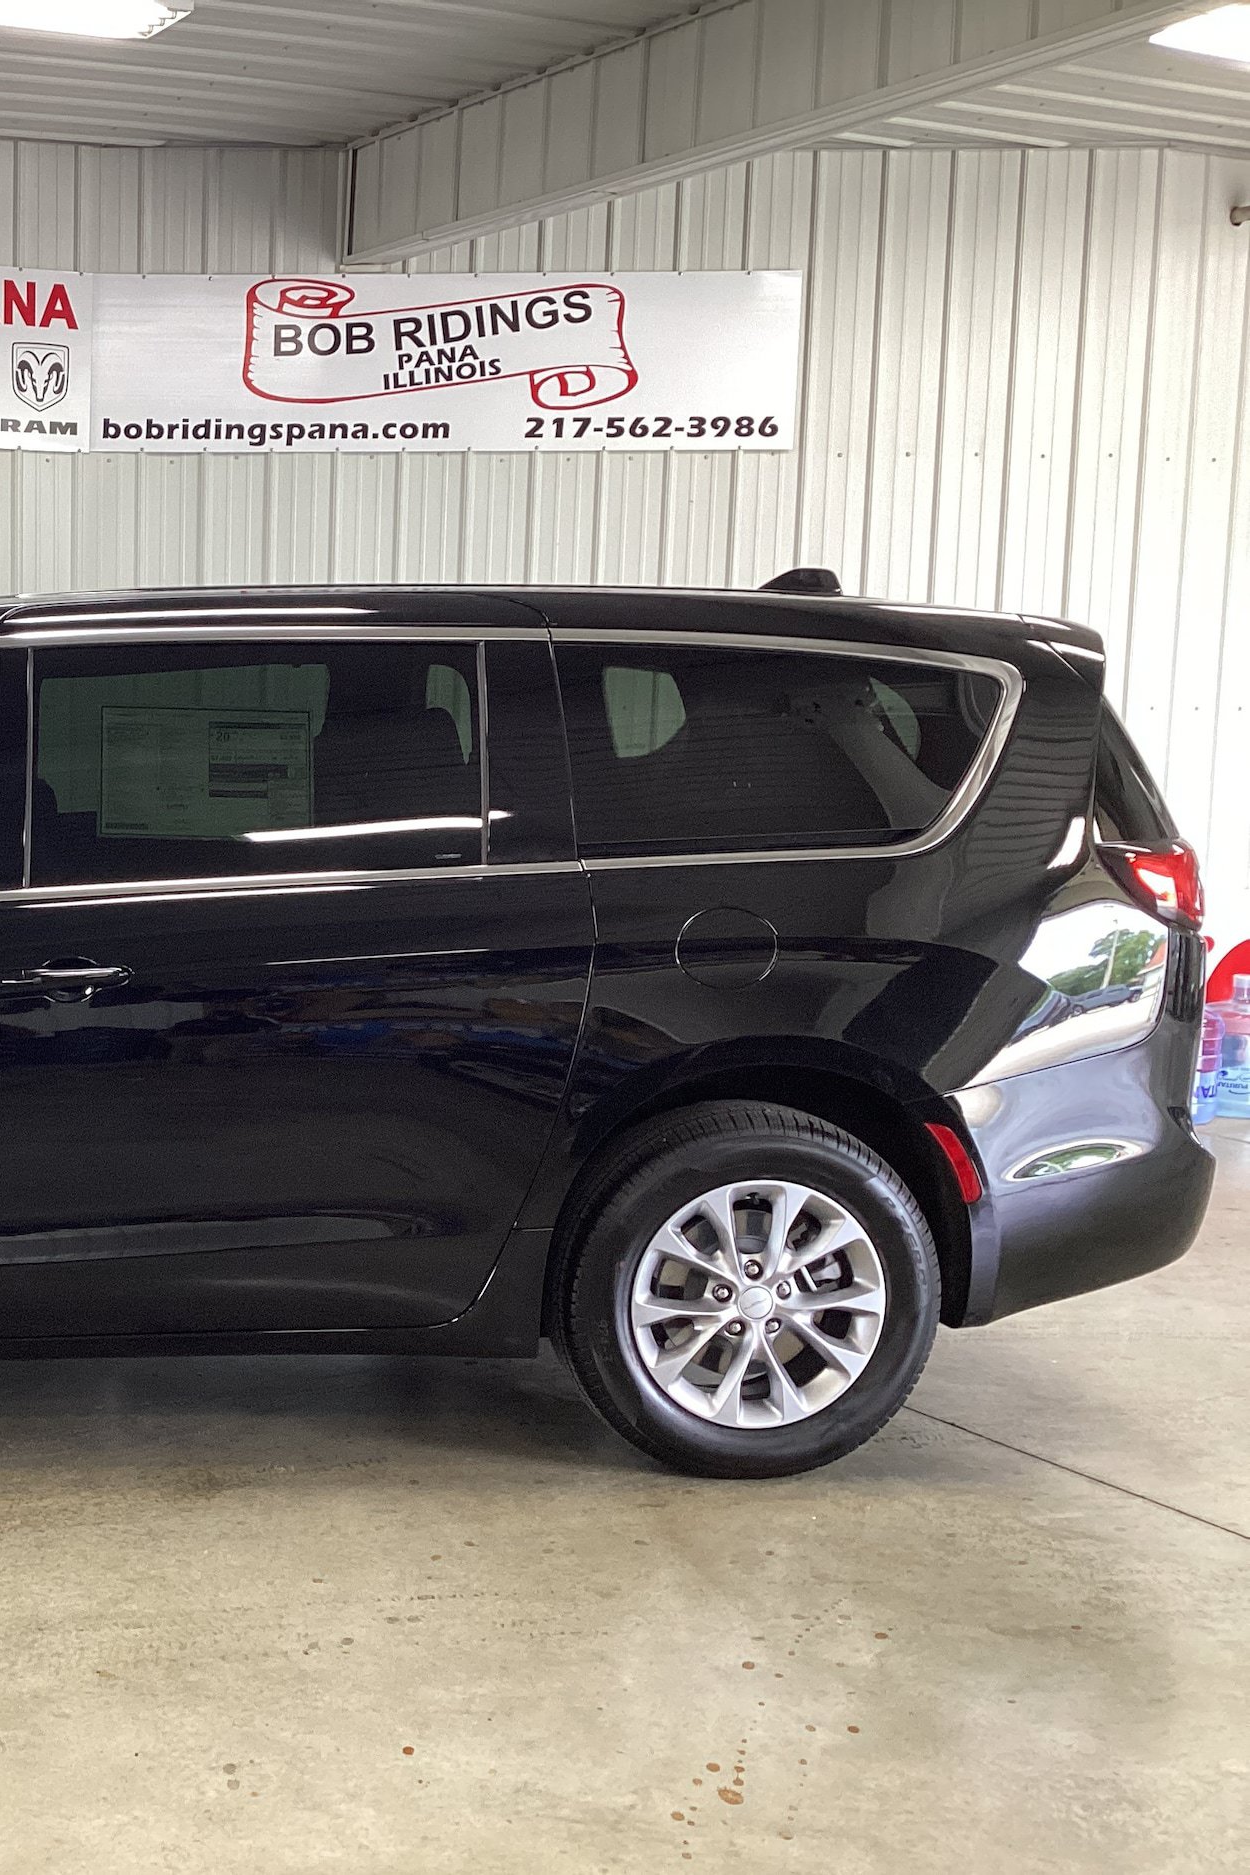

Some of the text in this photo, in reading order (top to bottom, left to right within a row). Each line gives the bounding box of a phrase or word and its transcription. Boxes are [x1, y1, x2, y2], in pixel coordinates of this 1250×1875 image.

[273, 290, 593, 357] BOB RIDINGS
[397, 344, 480, 371] PANA
[382, 358, 502, 391] ILLINOIS
[0, 418, 78, 436] RAM
[102, 417, 450, 447] bobridingspana.com
[524, 416, 779, 439] 217-562-3986
